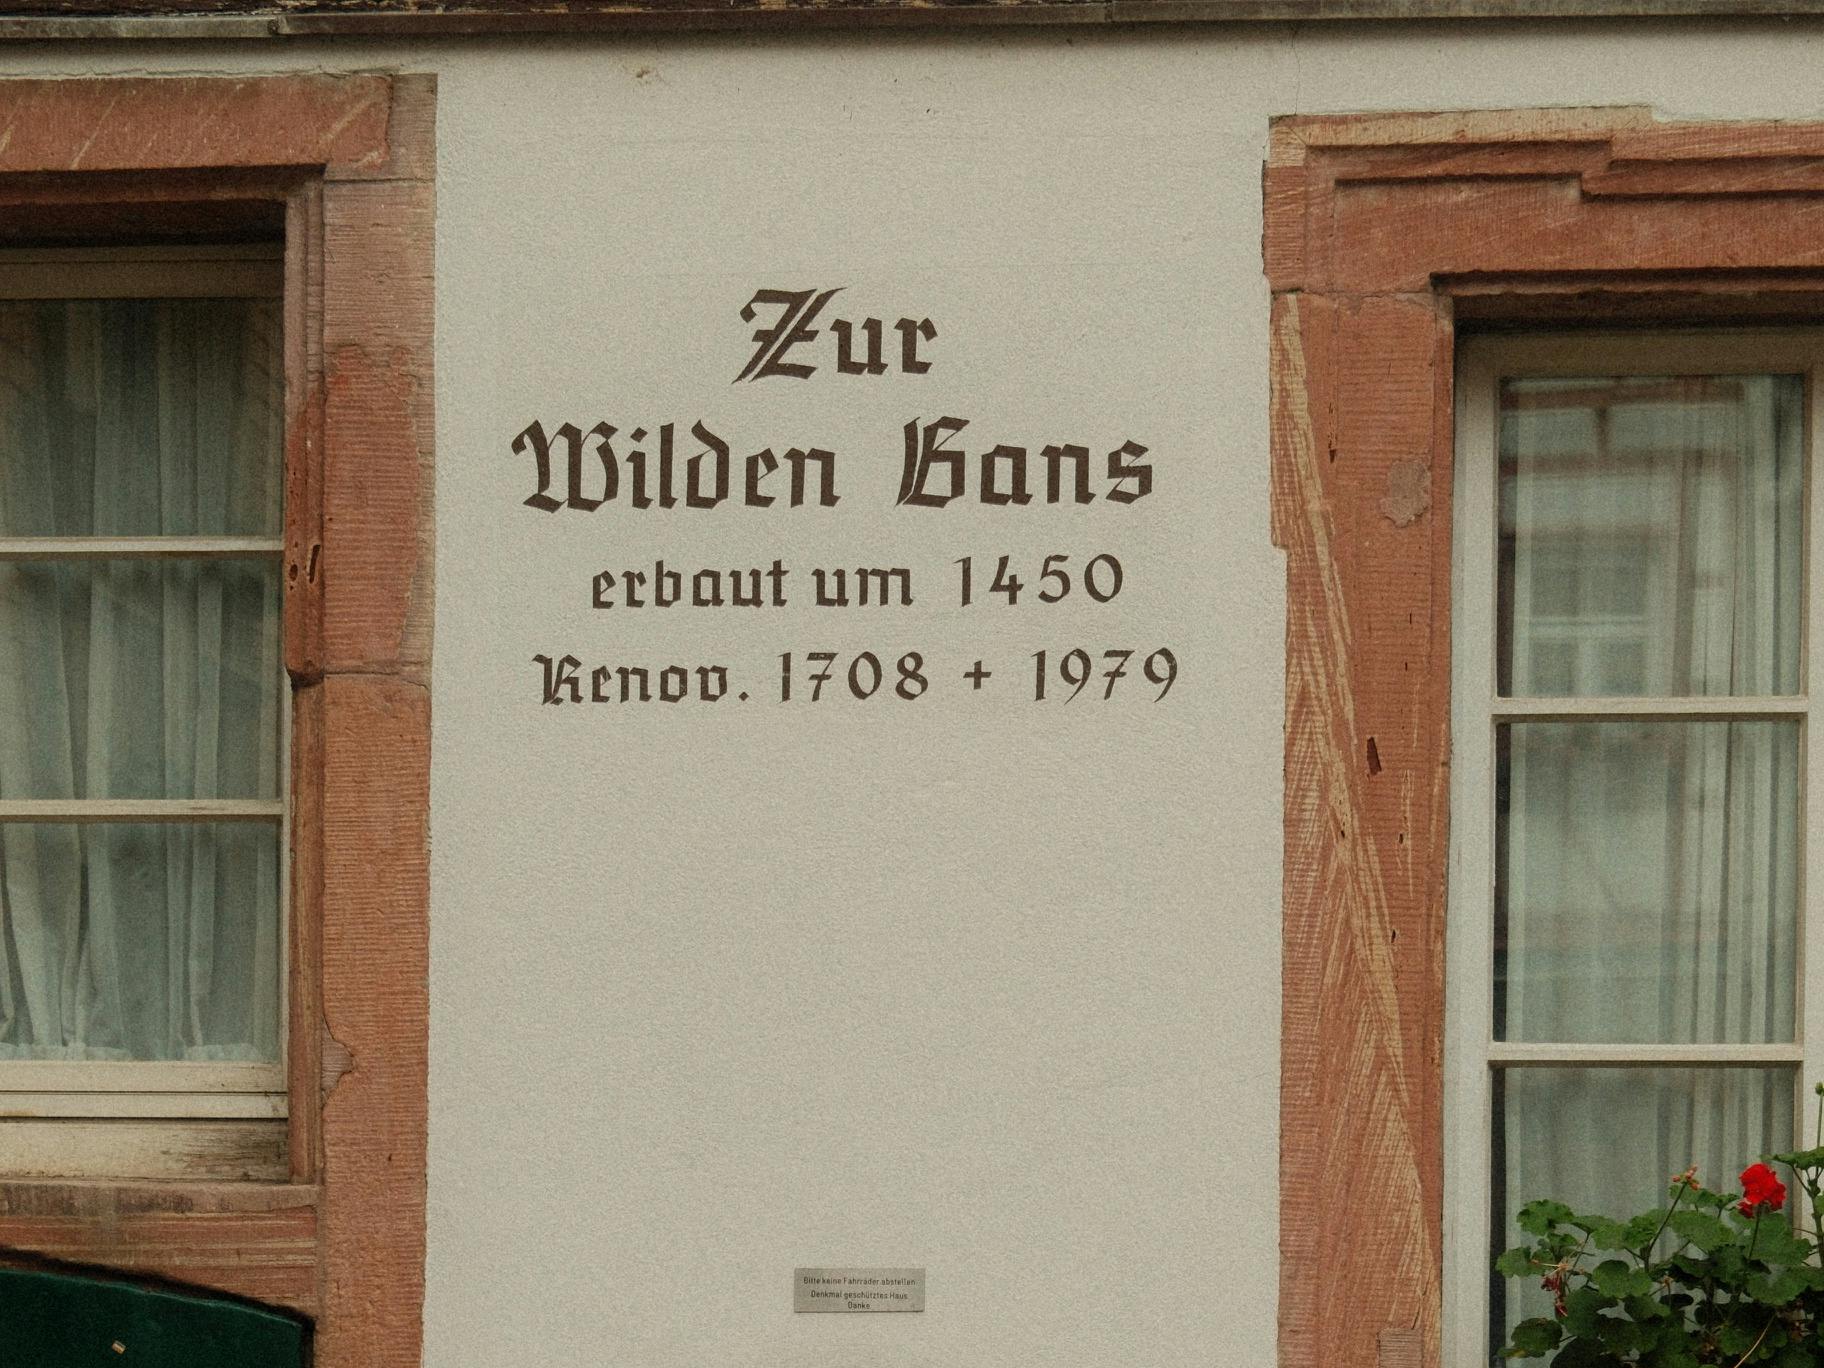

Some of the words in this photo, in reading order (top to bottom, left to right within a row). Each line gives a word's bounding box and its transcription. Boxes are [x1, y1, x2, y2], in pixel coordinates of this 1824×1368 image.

[731, 287, 938, 385] Zur
[511, 418, 841, 514] Wilden
[895, 415, 1153, 509] Gans
[592, 559, 790, 609] erbaut
[811, 567, 914, 608] um
[954, 553, 1123, 608] 1450
[531, 653, 749, 706] Renov.
[779, 651, 929, 702] 1708
[963, 660, 992, 690] +
[1032, 647, 1178, 703] 1979
[803, 1276, 821, 1285] Bitte
[821, 1276, 842, 1285] keine
[843, 1276, 879, 1286] Fahrräder
[881, 1276, 916, 1286] abstellen
[810, 1290, 842, 1298] Denkmal
[844, 1290, 888, 1300] geschütztes
[889, 1291, 908, 1300] Haus
[847, 1301, 870, 1310] Danke
